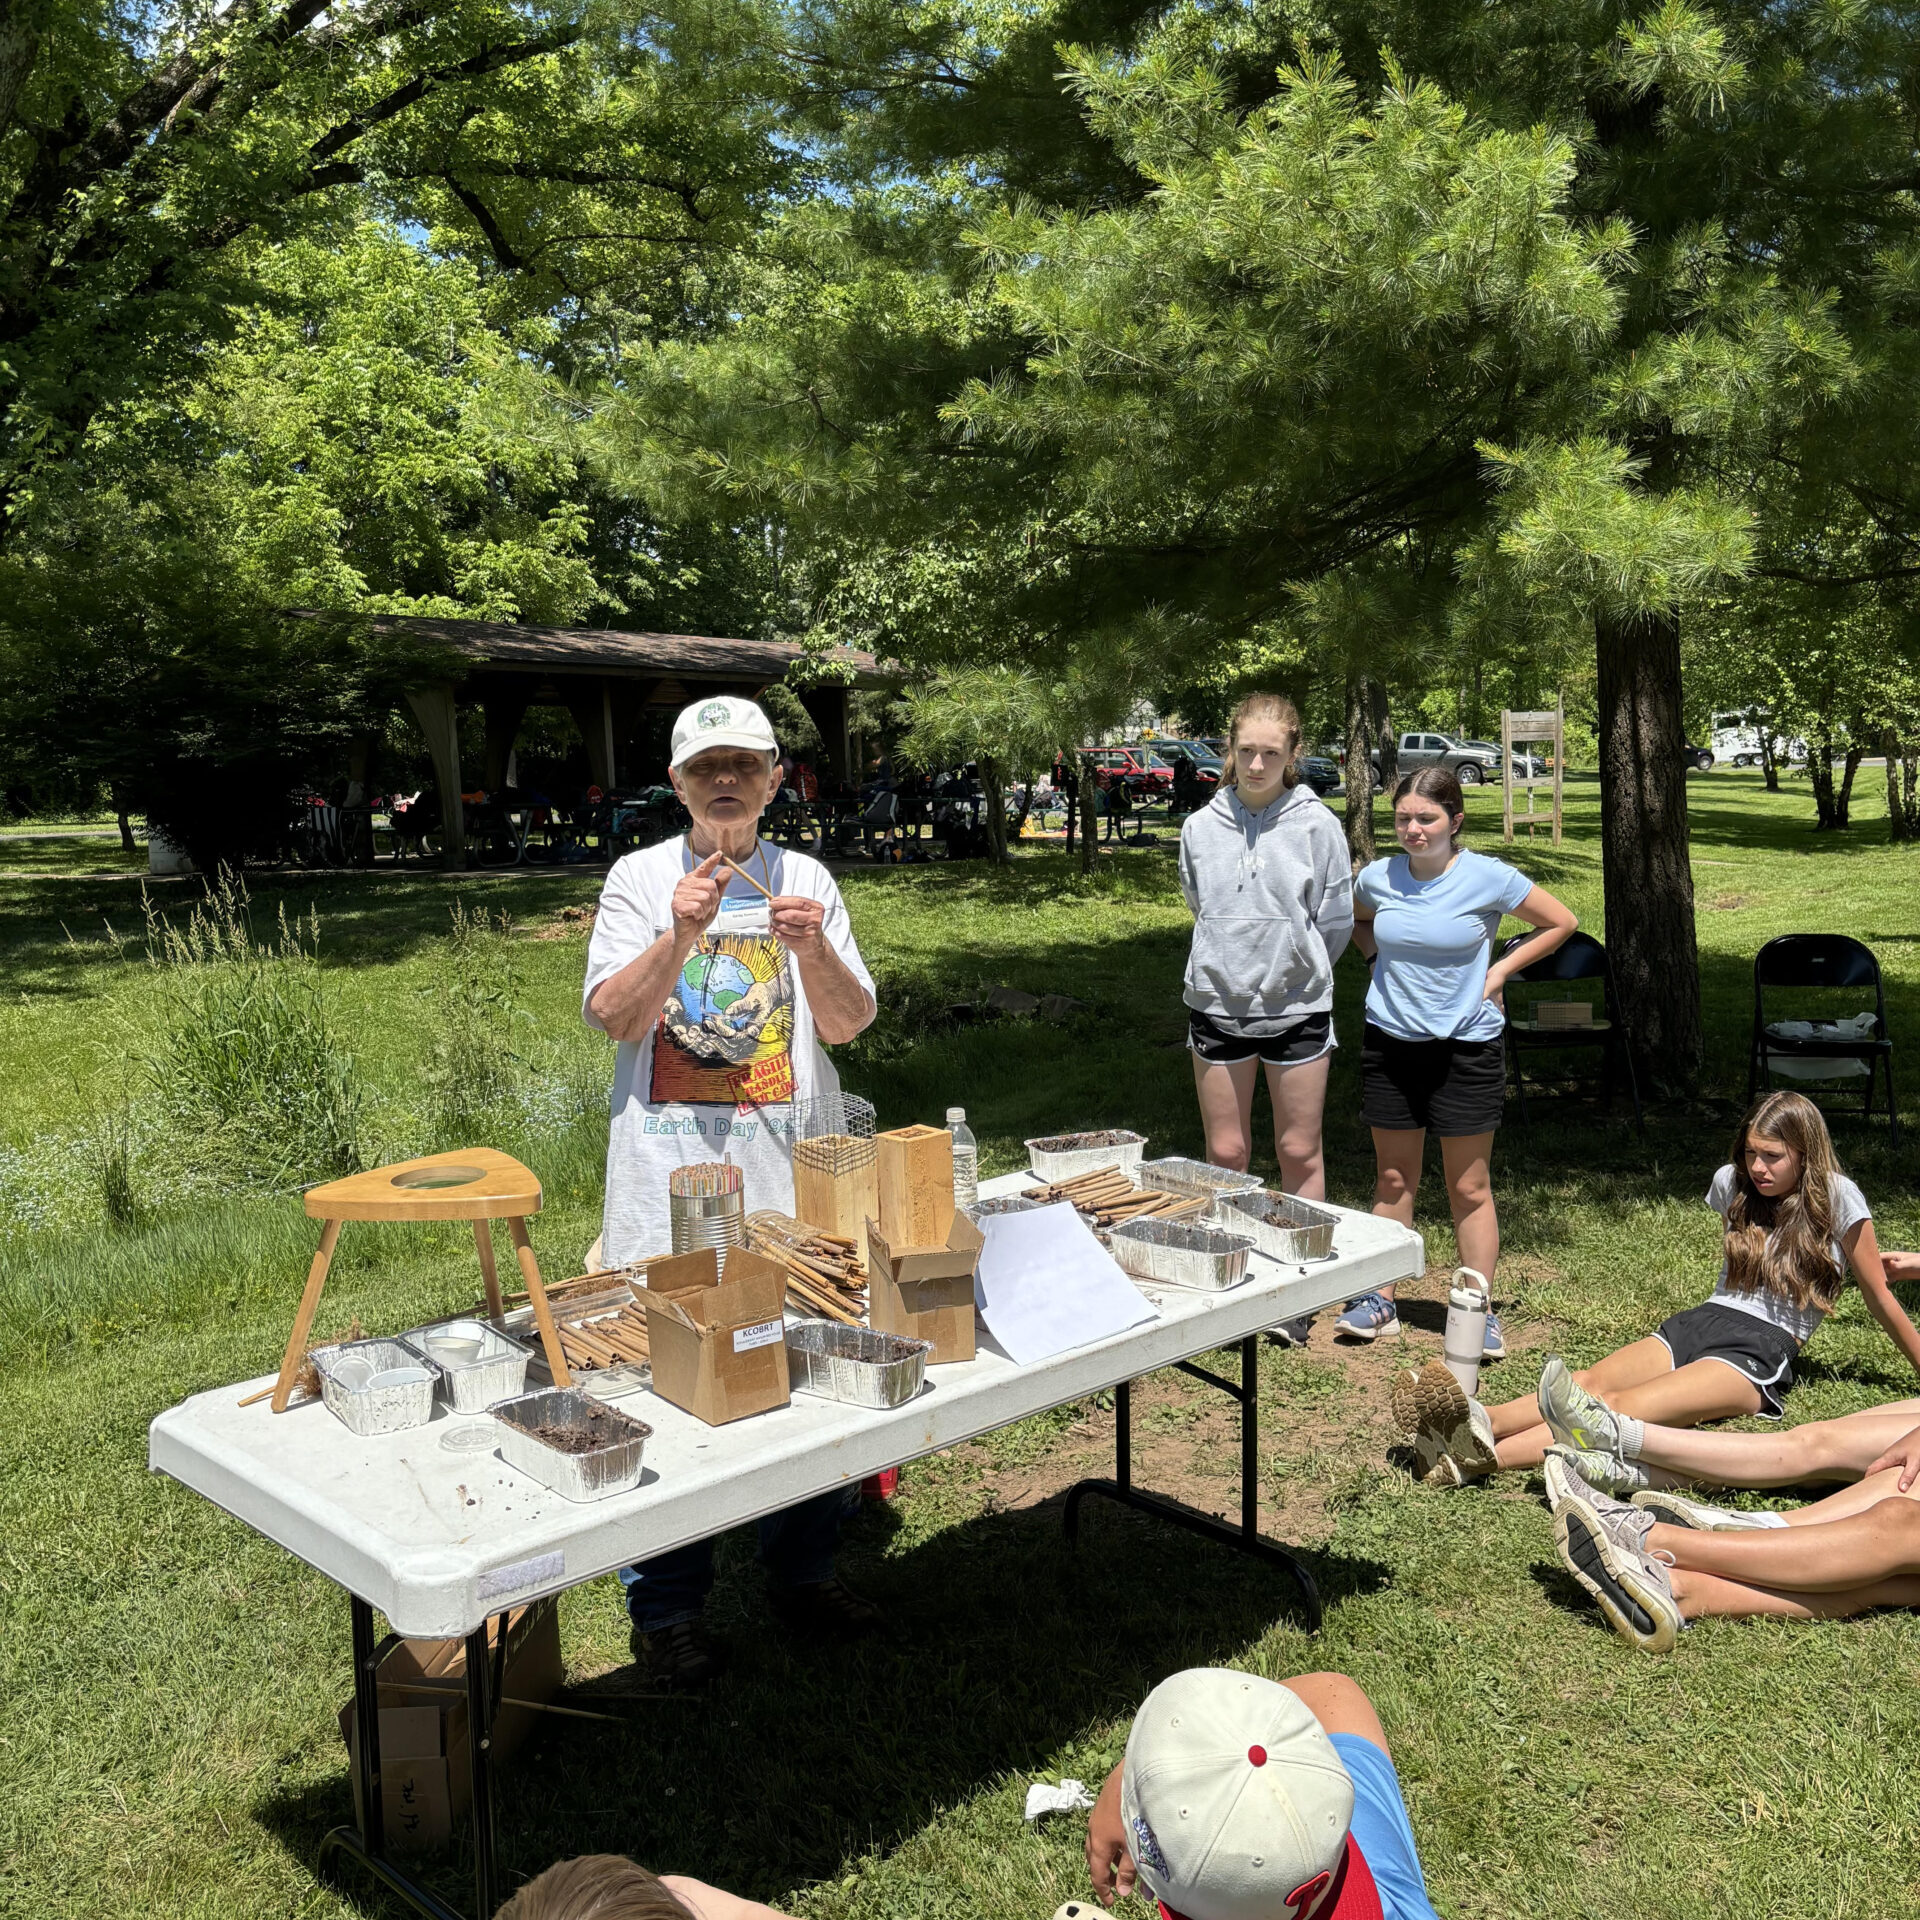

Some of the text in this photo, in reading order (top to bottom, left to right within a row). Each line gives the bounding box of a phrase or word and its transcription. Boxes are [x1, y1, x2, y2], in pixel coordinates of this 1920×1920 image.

[732, 1053, 788, 1088] FRAGILE
[744, 1071, 788, 1097] HANDLE
[643, 1116, 793, 1142] Earth Day '94
[742, 1322, 774, 1338] KCOBRT
